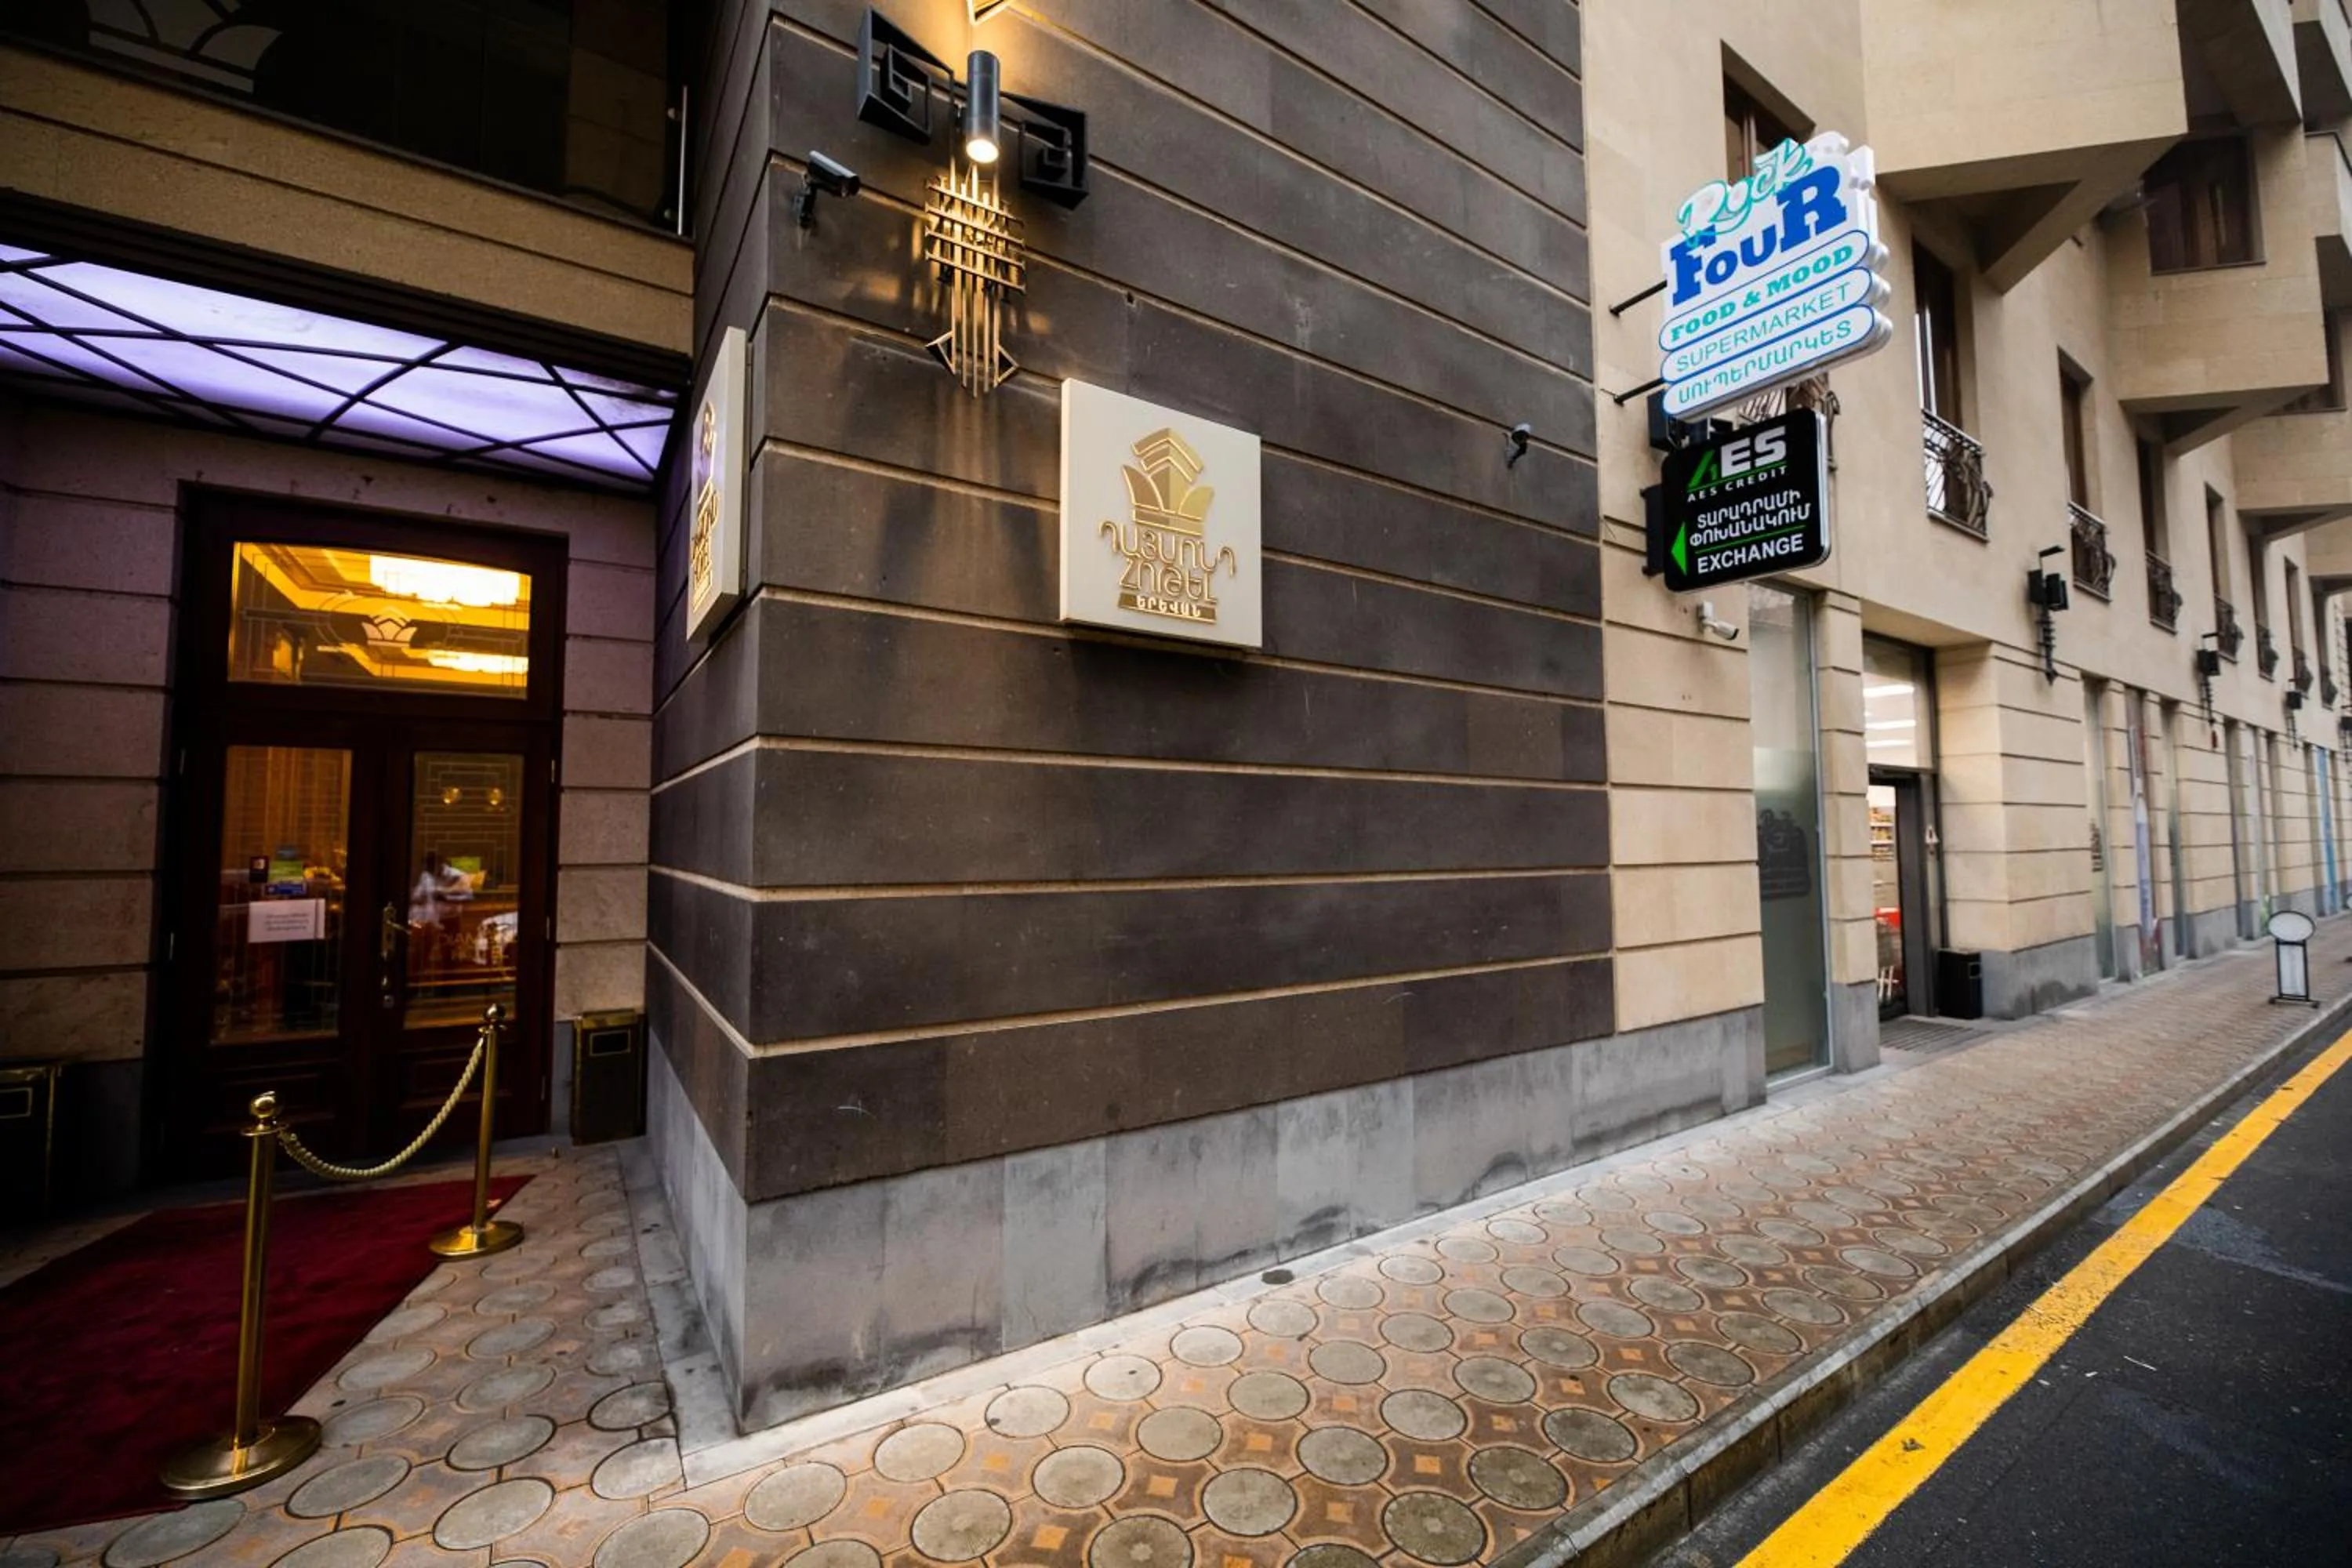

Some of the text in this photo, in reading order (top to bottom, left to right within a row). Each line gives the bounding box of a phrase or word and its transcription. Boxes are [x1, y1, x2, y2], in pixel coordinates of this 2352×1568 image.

[1670, 245, 1853, 343] FOOD & MOOD
[1676, 281, 1851, 372] SUPERMARKET
[1687, 465, 1788, 503] AES CREDIT
[1688, 426, 1787, 488] AES
[1697, 533, 1804, 574] EXCHANGE
